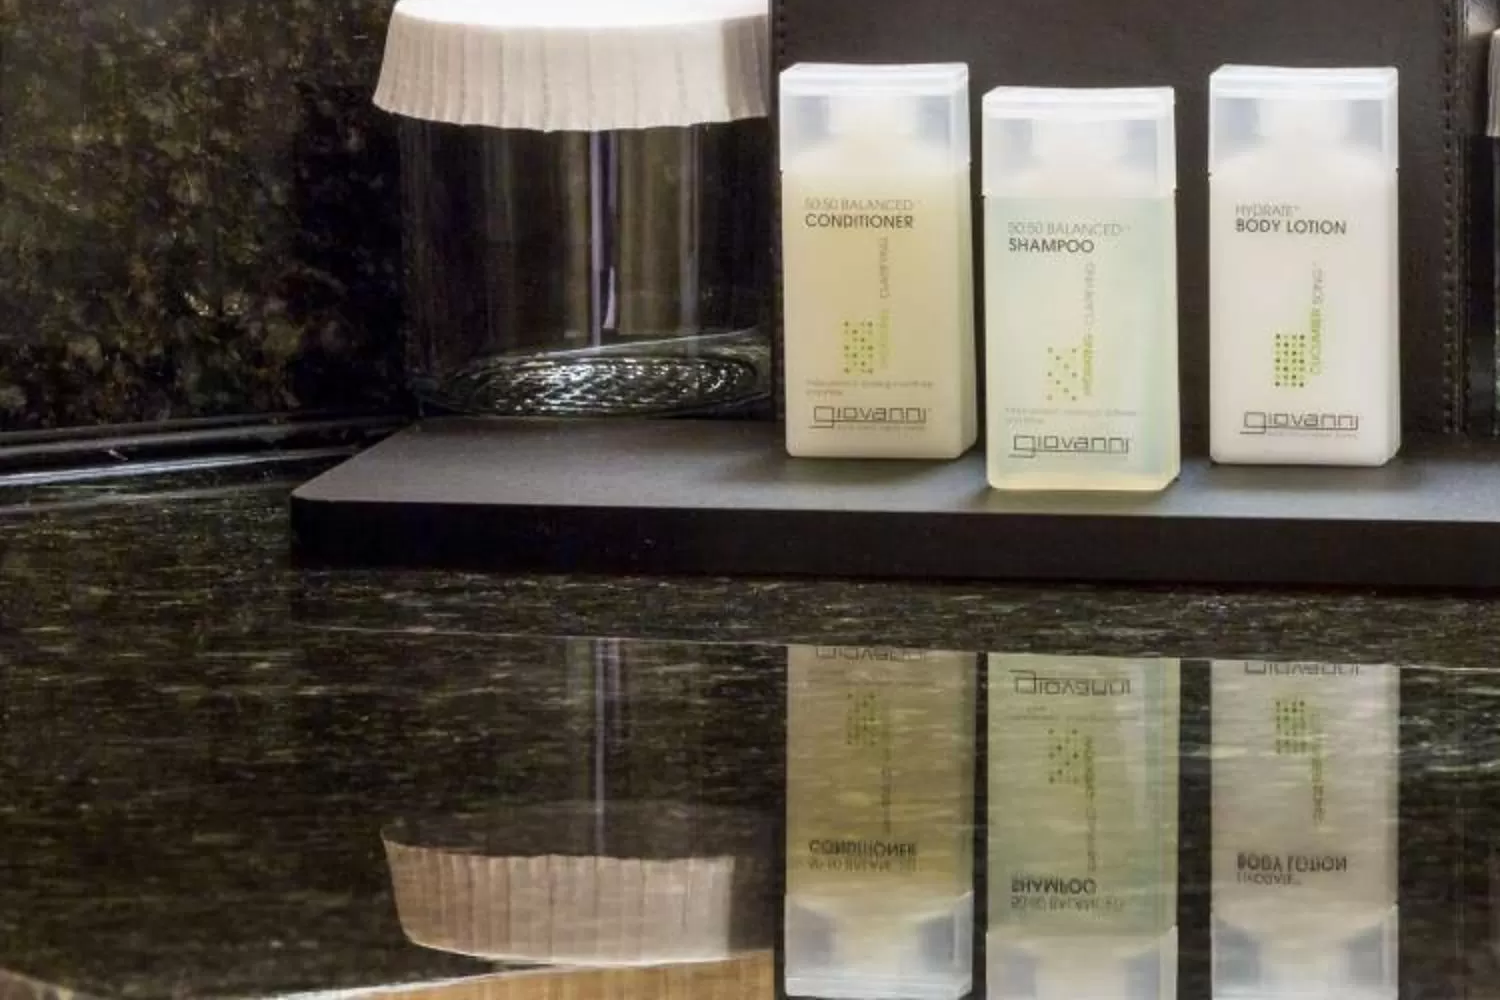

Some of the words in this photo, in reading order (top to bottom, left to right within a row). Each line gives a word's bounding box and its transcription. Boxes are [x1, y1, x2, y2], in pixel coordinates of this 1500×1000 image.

[841, 198, 914, 212] BALANCED
[805, 213, 914, 229] CONDITIONER
[1047, 221, 1122, 237] BALANCED
[1235, 218, 1281, 234] BODY
[1286, 219, 1347, 235] LOTION
[1008, 237, 1096, 254] SHAMPOO
[808, 405, 927, 429] giovanni
[1240, 411, 1359, 434] giovanni
[1007, 434, 1130, 458] giovanni
